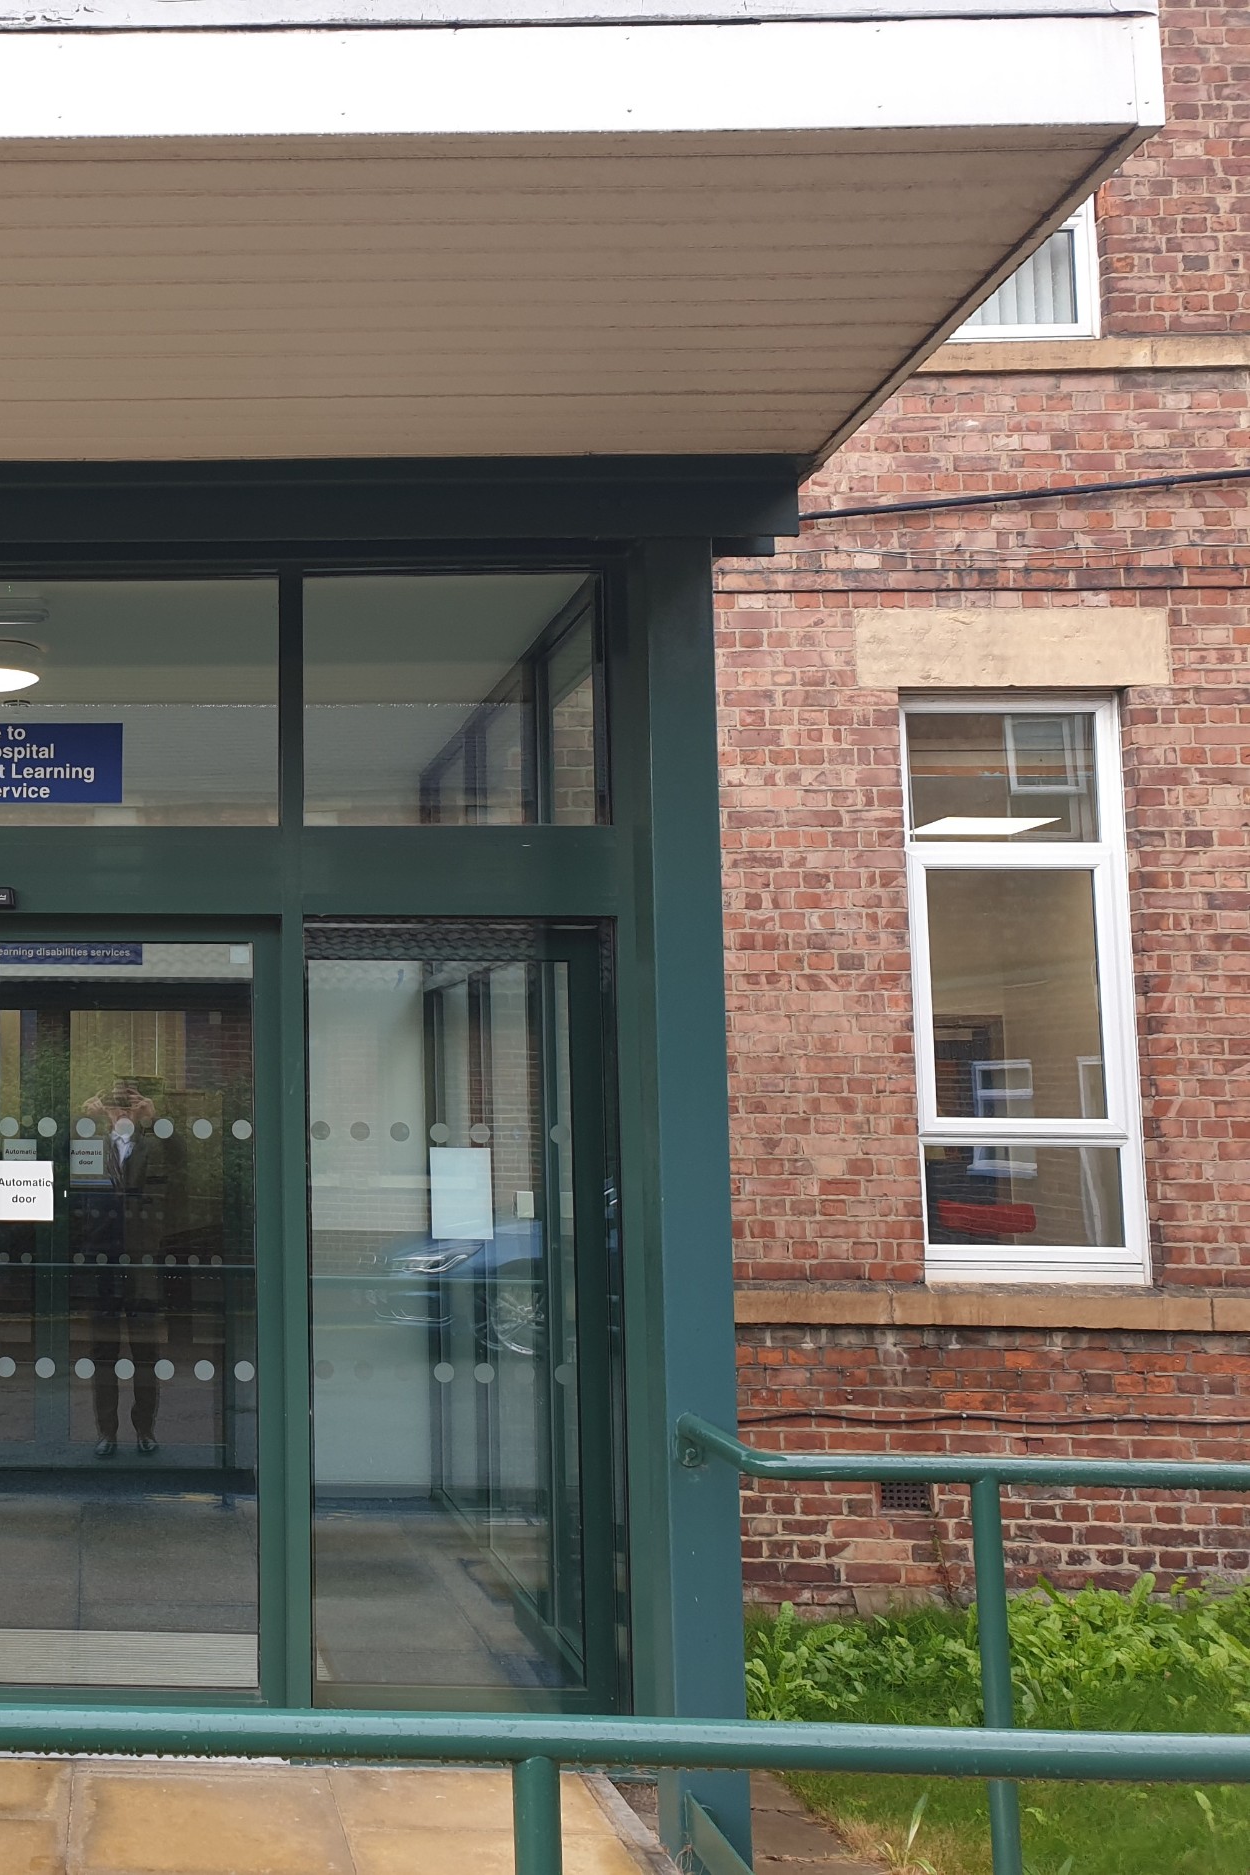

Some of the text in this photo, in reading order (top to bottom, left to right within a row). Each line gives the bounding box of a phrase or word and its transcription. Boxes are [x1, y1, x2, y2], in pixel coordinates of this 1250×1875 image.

[7, 725, 26, 740] to
[11, 763, 95, 783] Learning
[36, 947, 88, 957] disabilities
[90, 947, 131, 957] services
[11, 1194, 37, 1203] door
